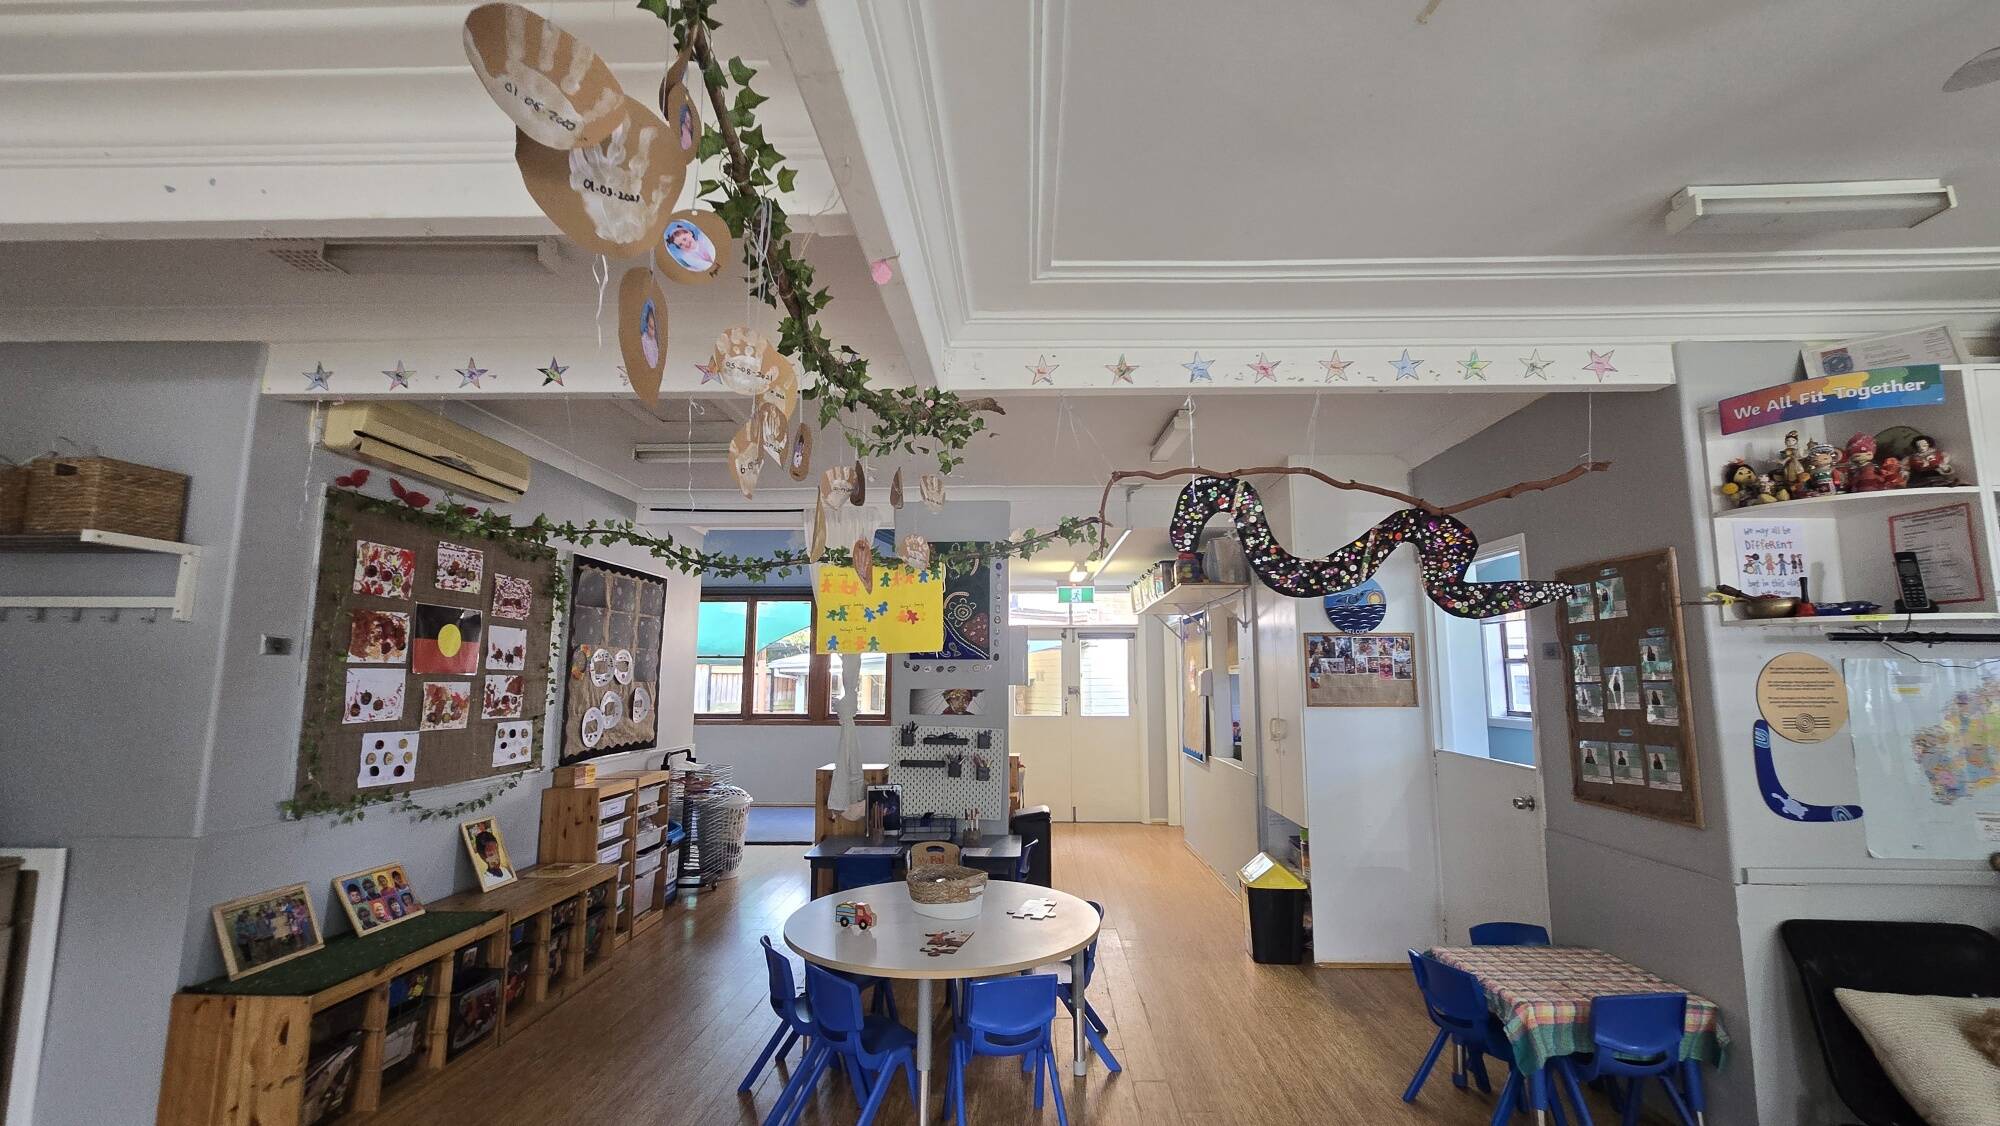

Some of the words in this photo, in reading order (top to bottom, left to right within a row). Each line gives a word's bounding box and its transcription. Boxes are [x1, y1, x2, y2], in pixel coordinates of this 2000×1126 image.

[1733, 405, 1761, 420] We
[1766, 395, 1793, 413] All
[1799, 390, 1827, 405] Fit
[1833, 379, 1926, 400] Together
